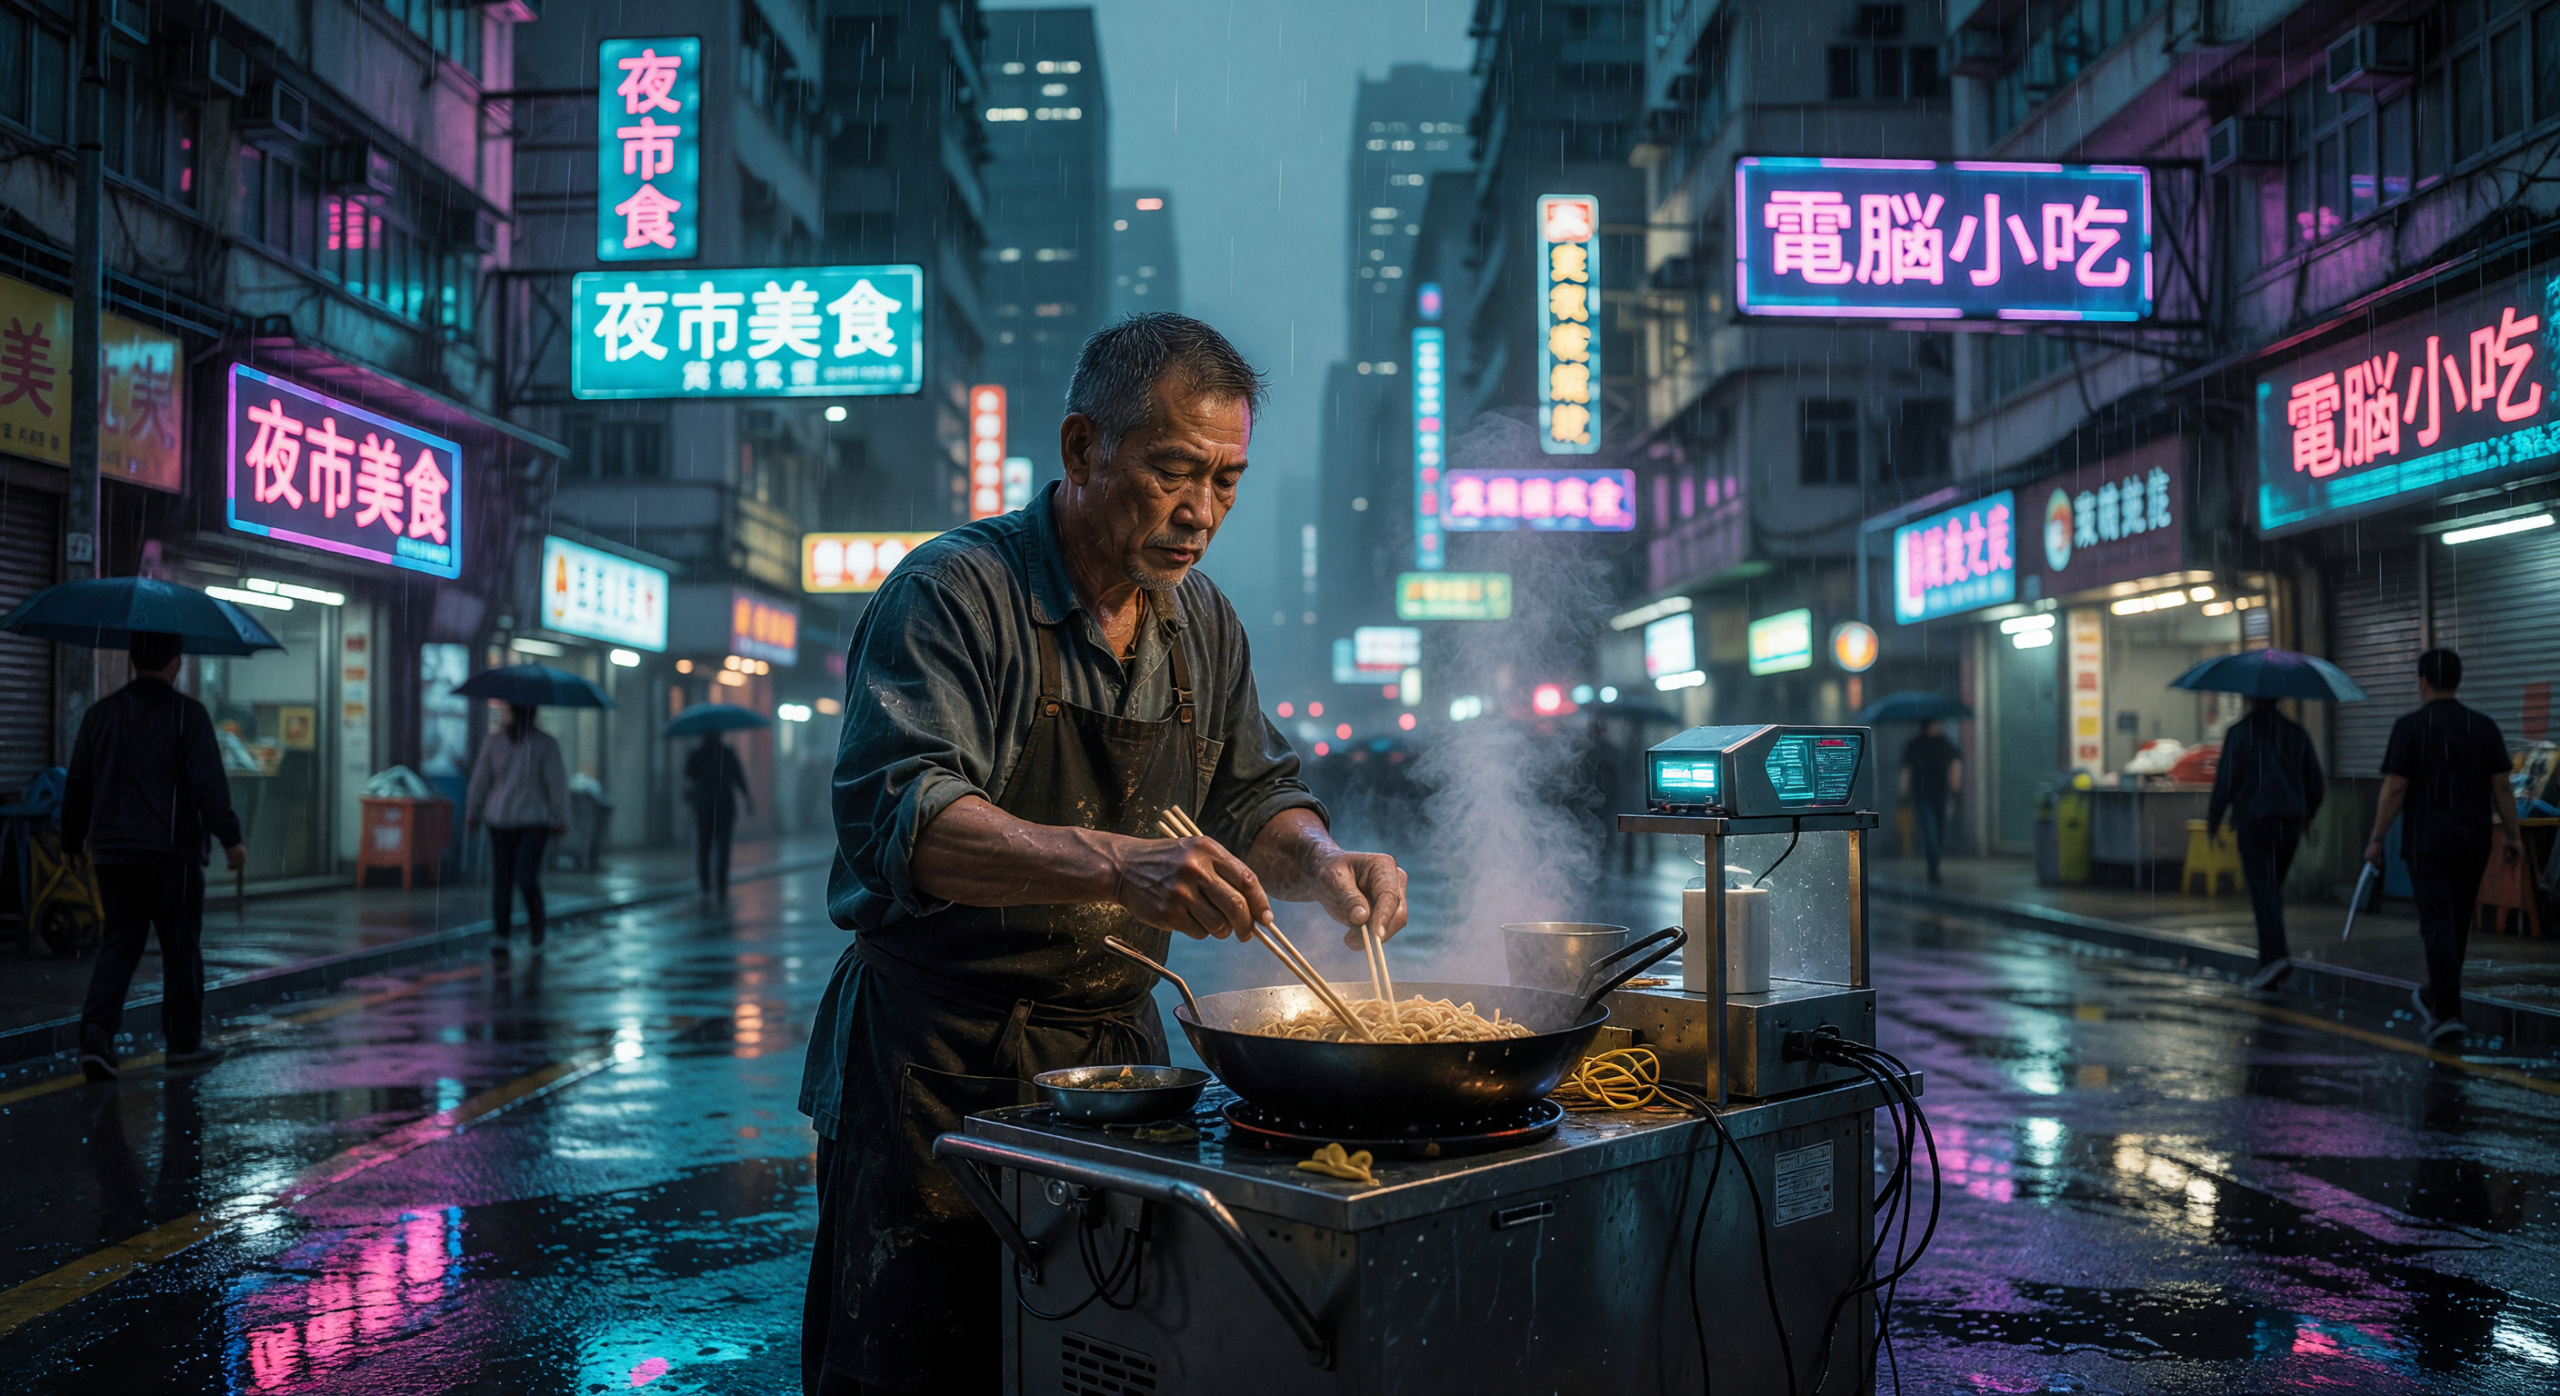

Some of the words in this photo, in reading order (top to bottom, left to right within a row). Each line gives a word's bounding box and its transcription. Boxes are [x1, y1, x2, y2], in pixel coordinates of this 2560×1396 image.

[615, 48, 682, 250] 夜市食
[1763, 190, 2131, 288] 電腦小吃
[593, 279, 903, 362] 夜市美食
[2286, 306, 2543, 478] 電腦小吃
[244, 398, 450, 545] 夜市美食
